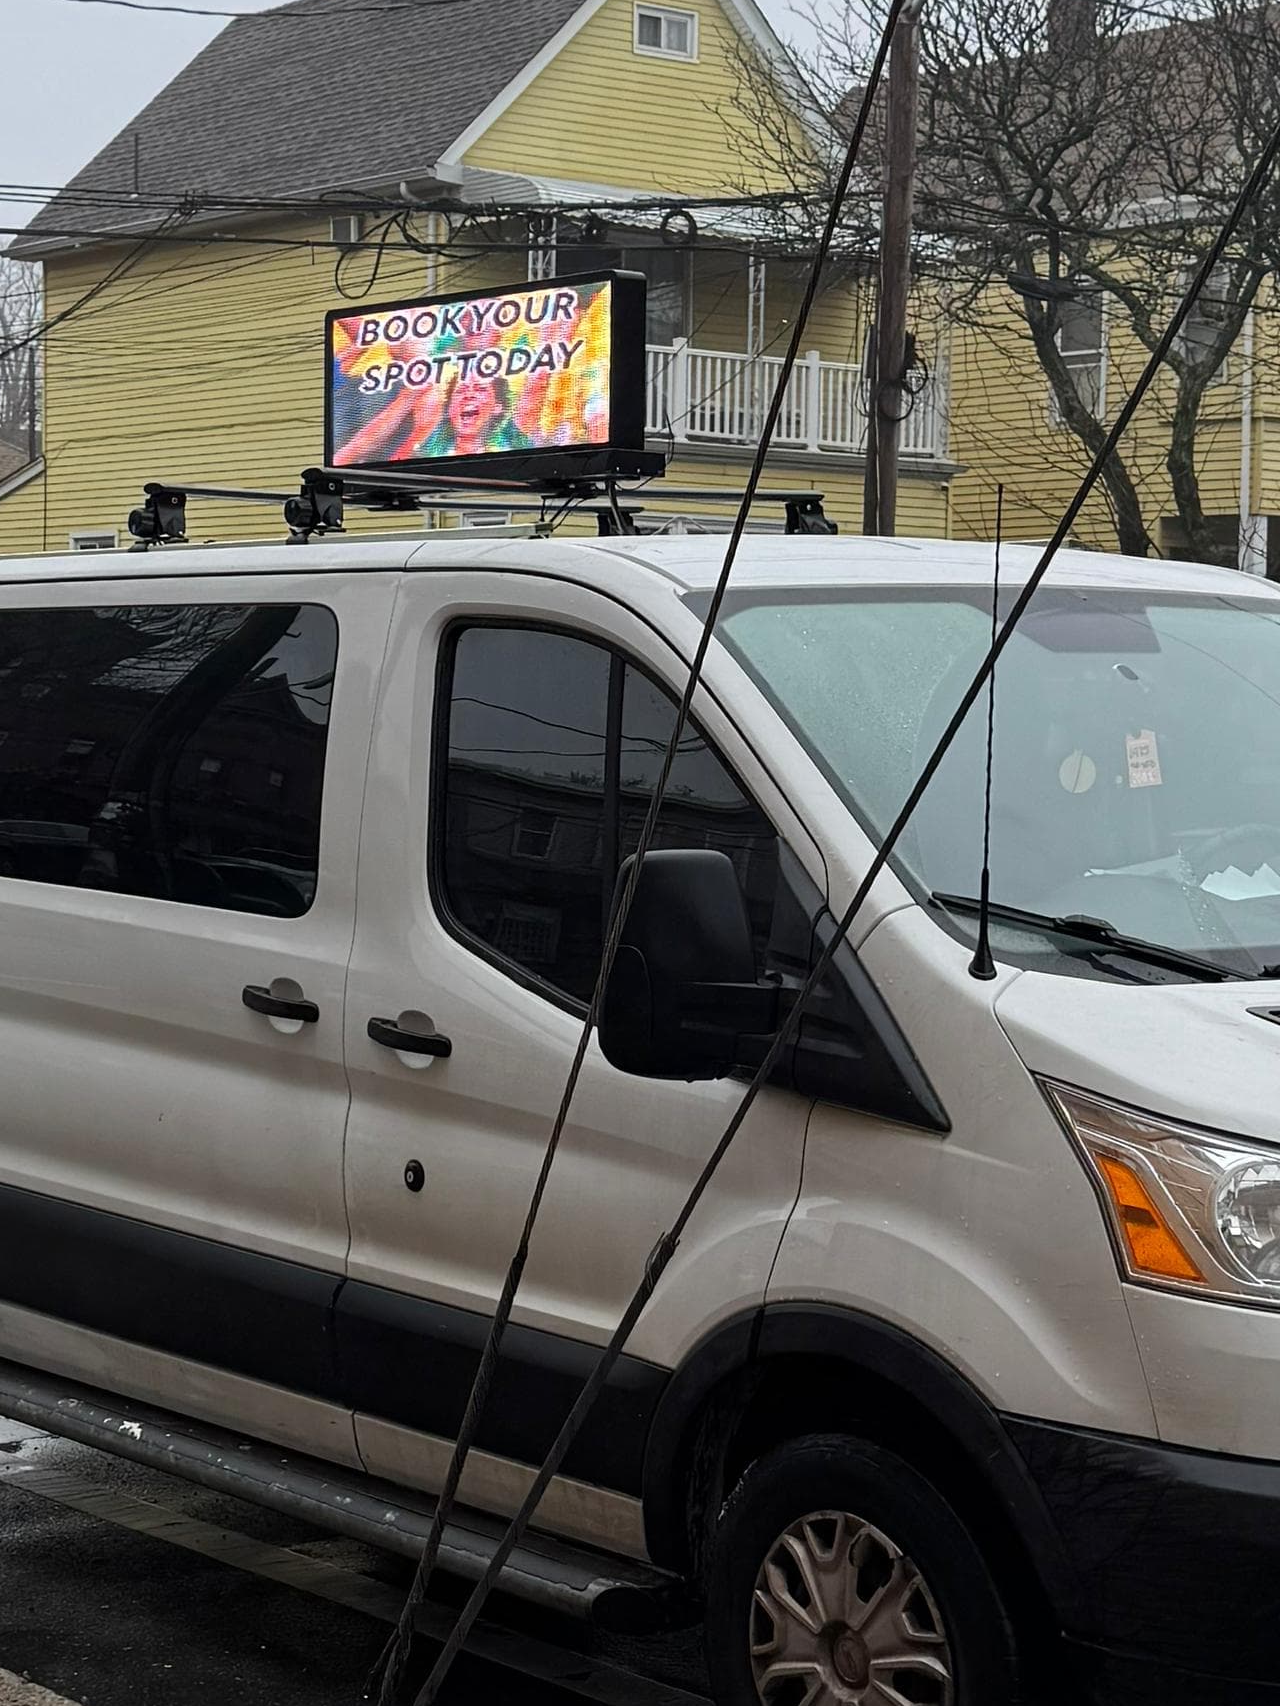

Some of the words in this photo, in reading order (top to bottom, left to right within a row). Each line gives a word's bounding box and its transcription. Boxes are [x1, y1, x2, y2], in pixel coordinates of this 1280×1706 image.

[360, 305, 467, 347] BOOK
[470, 291, 579, 332] YOUR
[360, 354, 454, 395] SPOT
[455, 339, 584, 381] TODAY
